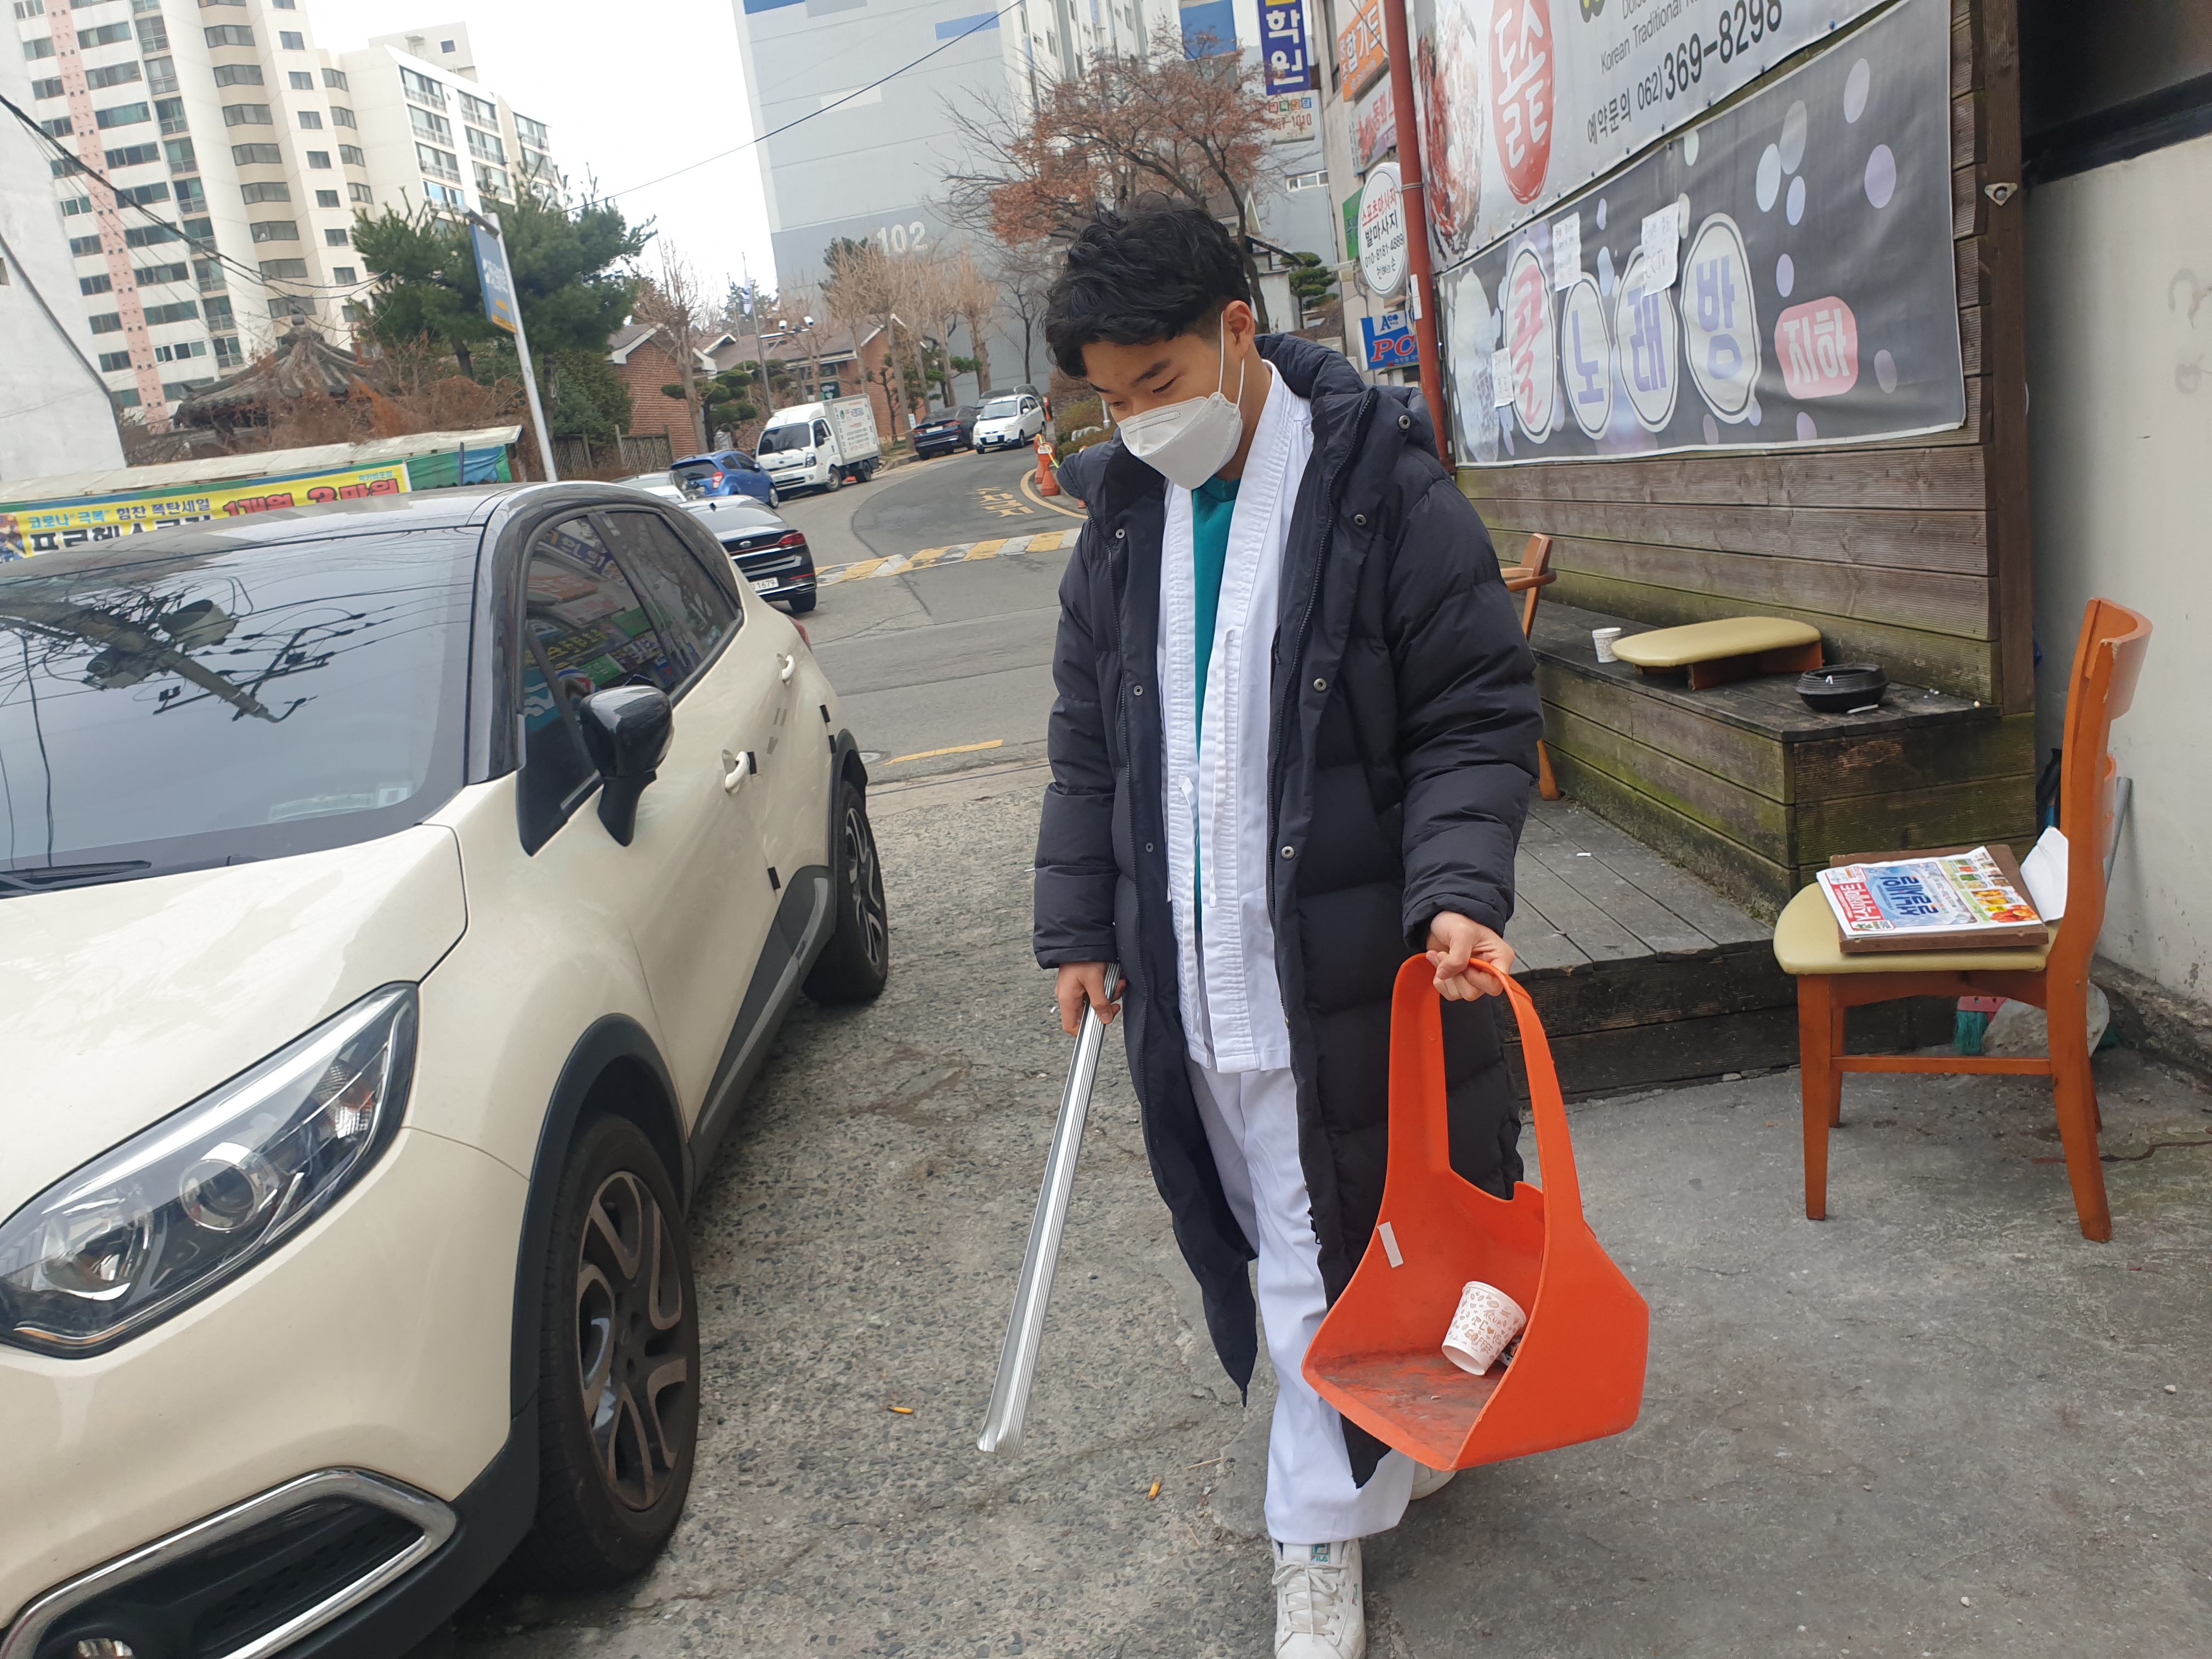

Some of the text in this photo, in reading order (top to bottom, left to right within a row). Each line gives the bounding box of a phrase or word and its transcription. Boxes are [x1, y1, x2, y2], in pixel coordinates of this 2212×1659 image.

[1600, 0, 1682, 75] Korean Traditional
[1587, 88, 1632, 145] 예약문의
[877, 221, 928, 257] 102
[1365, 209, 1398, 248] 발마사지
[1370, 334, 1416, 362] PC
[1782, 307, 1850, 385] 지하
[116, 505, 146, 521] 힘찬
[151, 498, 211, 516] 폭탄세일
[757, 579, 775, 589] 1679
